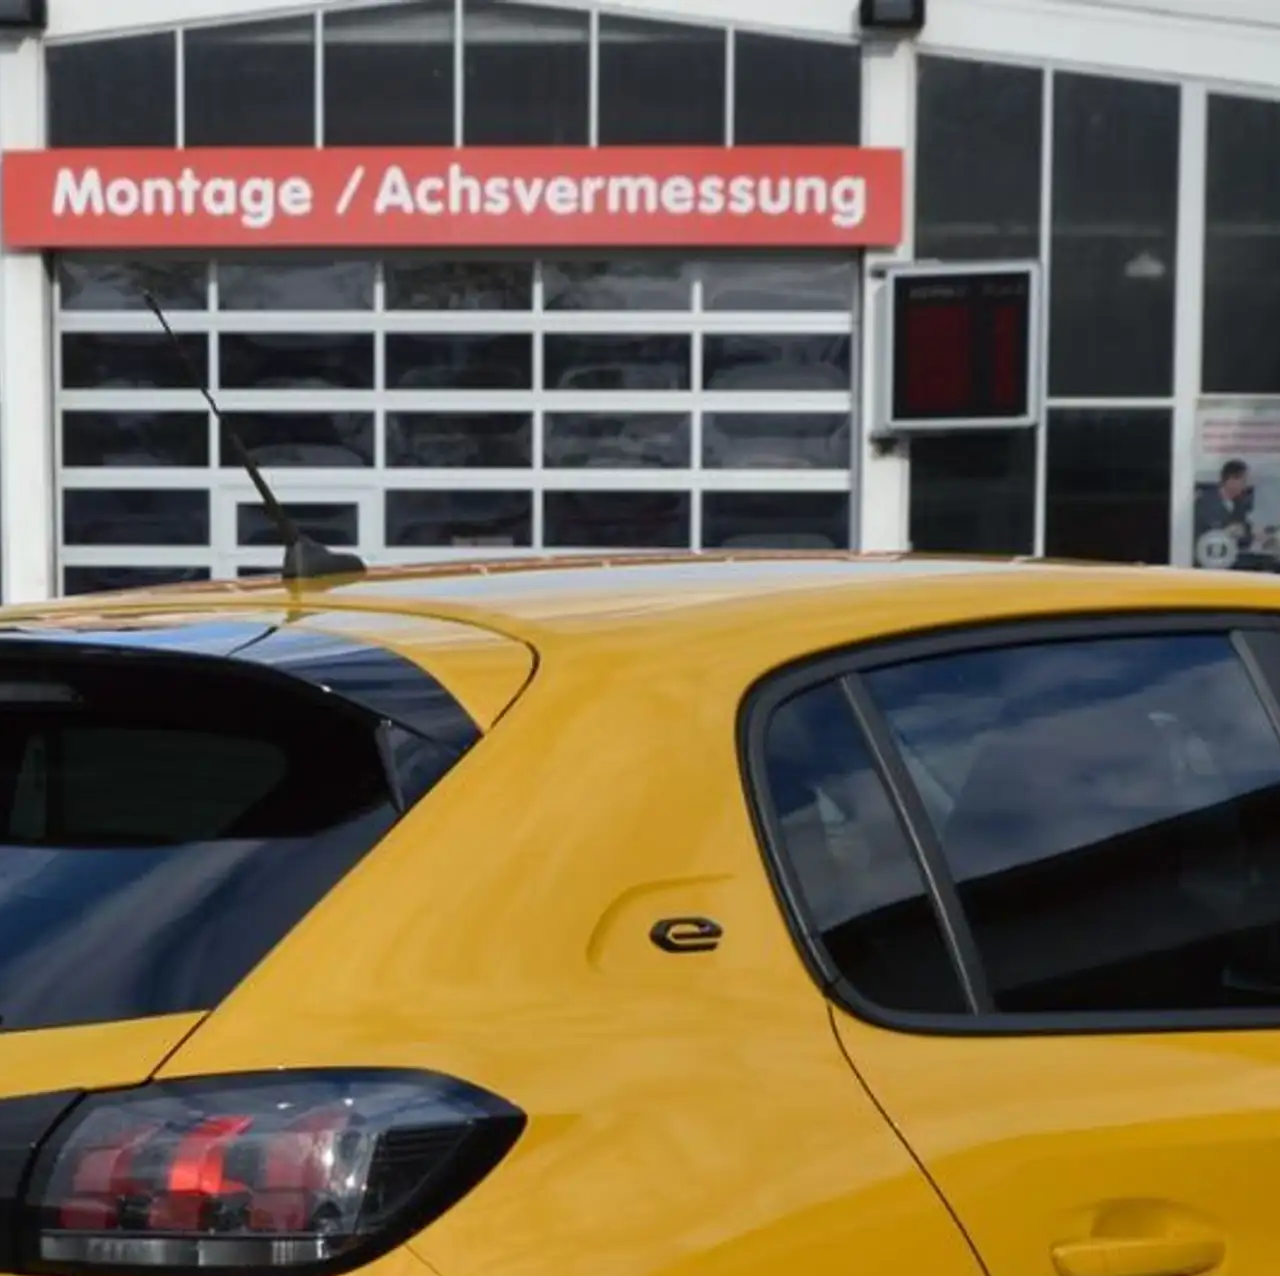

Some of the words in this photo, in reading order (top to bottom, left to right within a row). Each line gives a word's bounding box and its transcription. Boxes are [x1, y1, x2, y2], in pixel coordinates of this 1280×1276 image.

[51, 167, 313, 229] Montage
[335, 166, 365, 217] /
[373, 164, 868, 227] Achsvermessung
